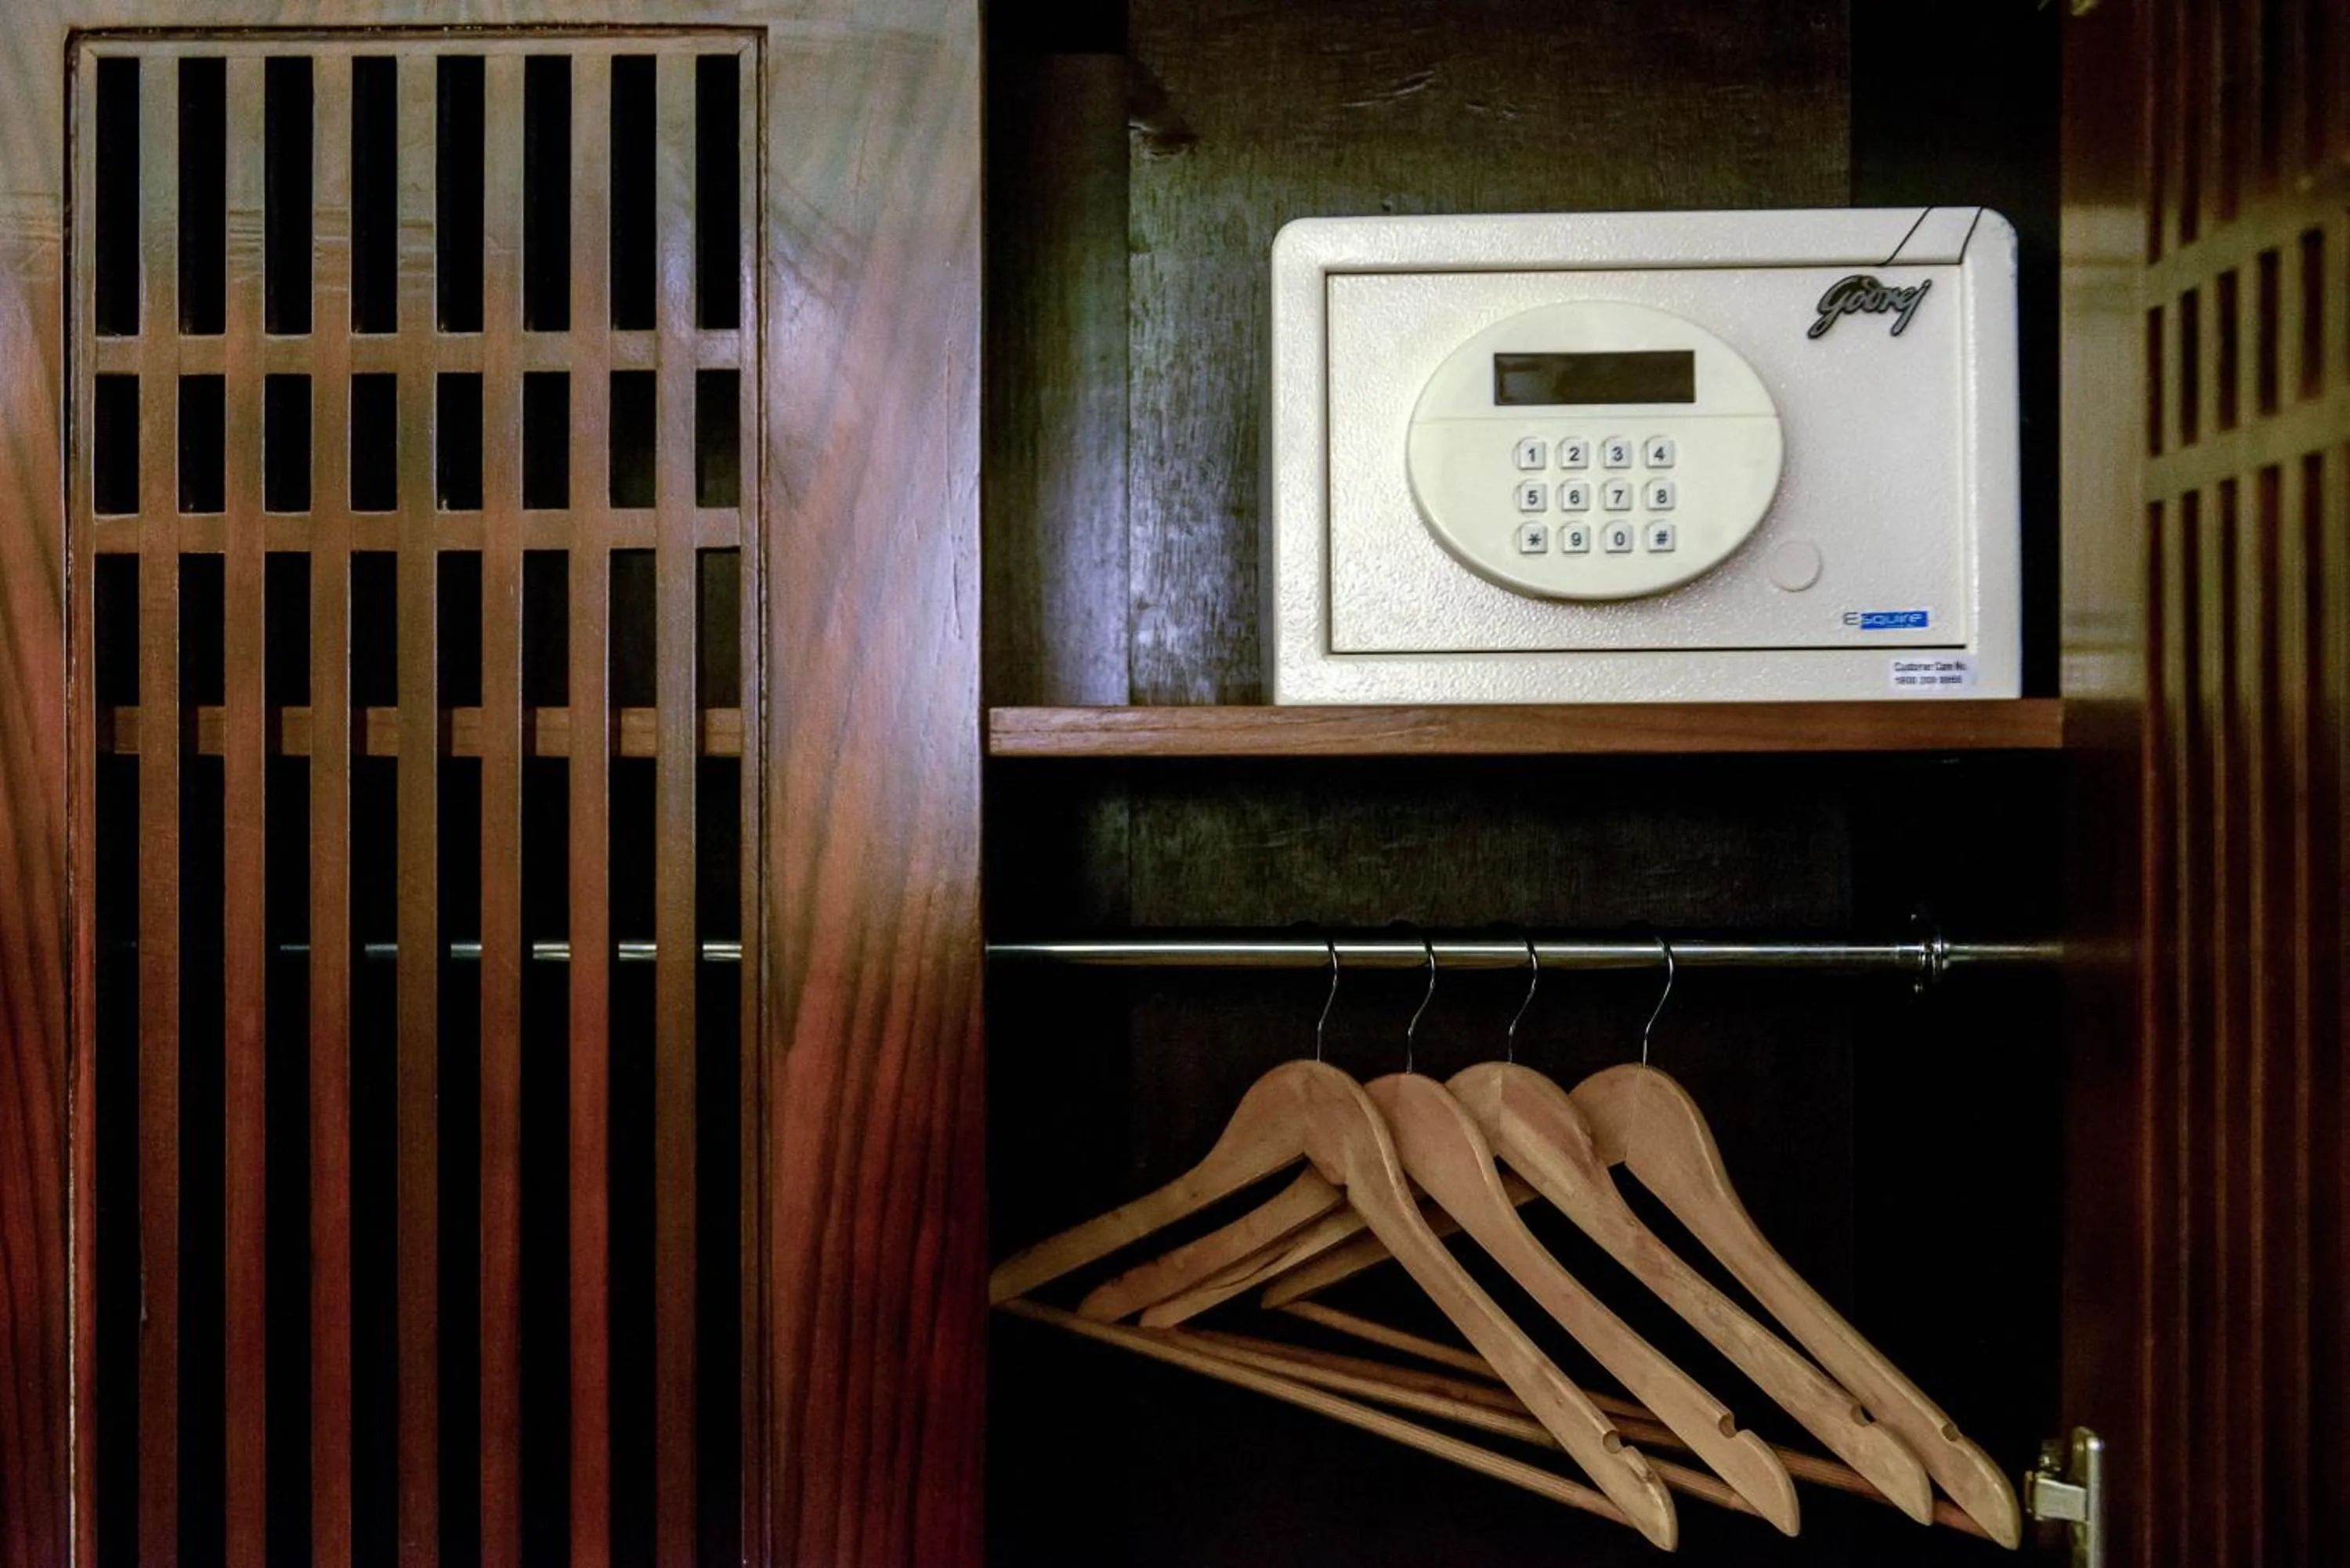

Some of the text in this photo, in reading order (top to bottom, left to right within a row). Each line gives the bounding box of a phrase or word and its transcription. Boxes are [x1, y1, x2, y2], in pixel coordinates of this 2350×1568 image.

[1807, 274, 1932, 340] Godrej
[1528, 446, 1665, 463] 1 2 3 4
[1528, 489, 1668, 505] 5 6 7 8
[1571, 532, 1582, 547] 9
[1614, 531, 1625, 547] 0
[1656, 530, 1668, 545] #
